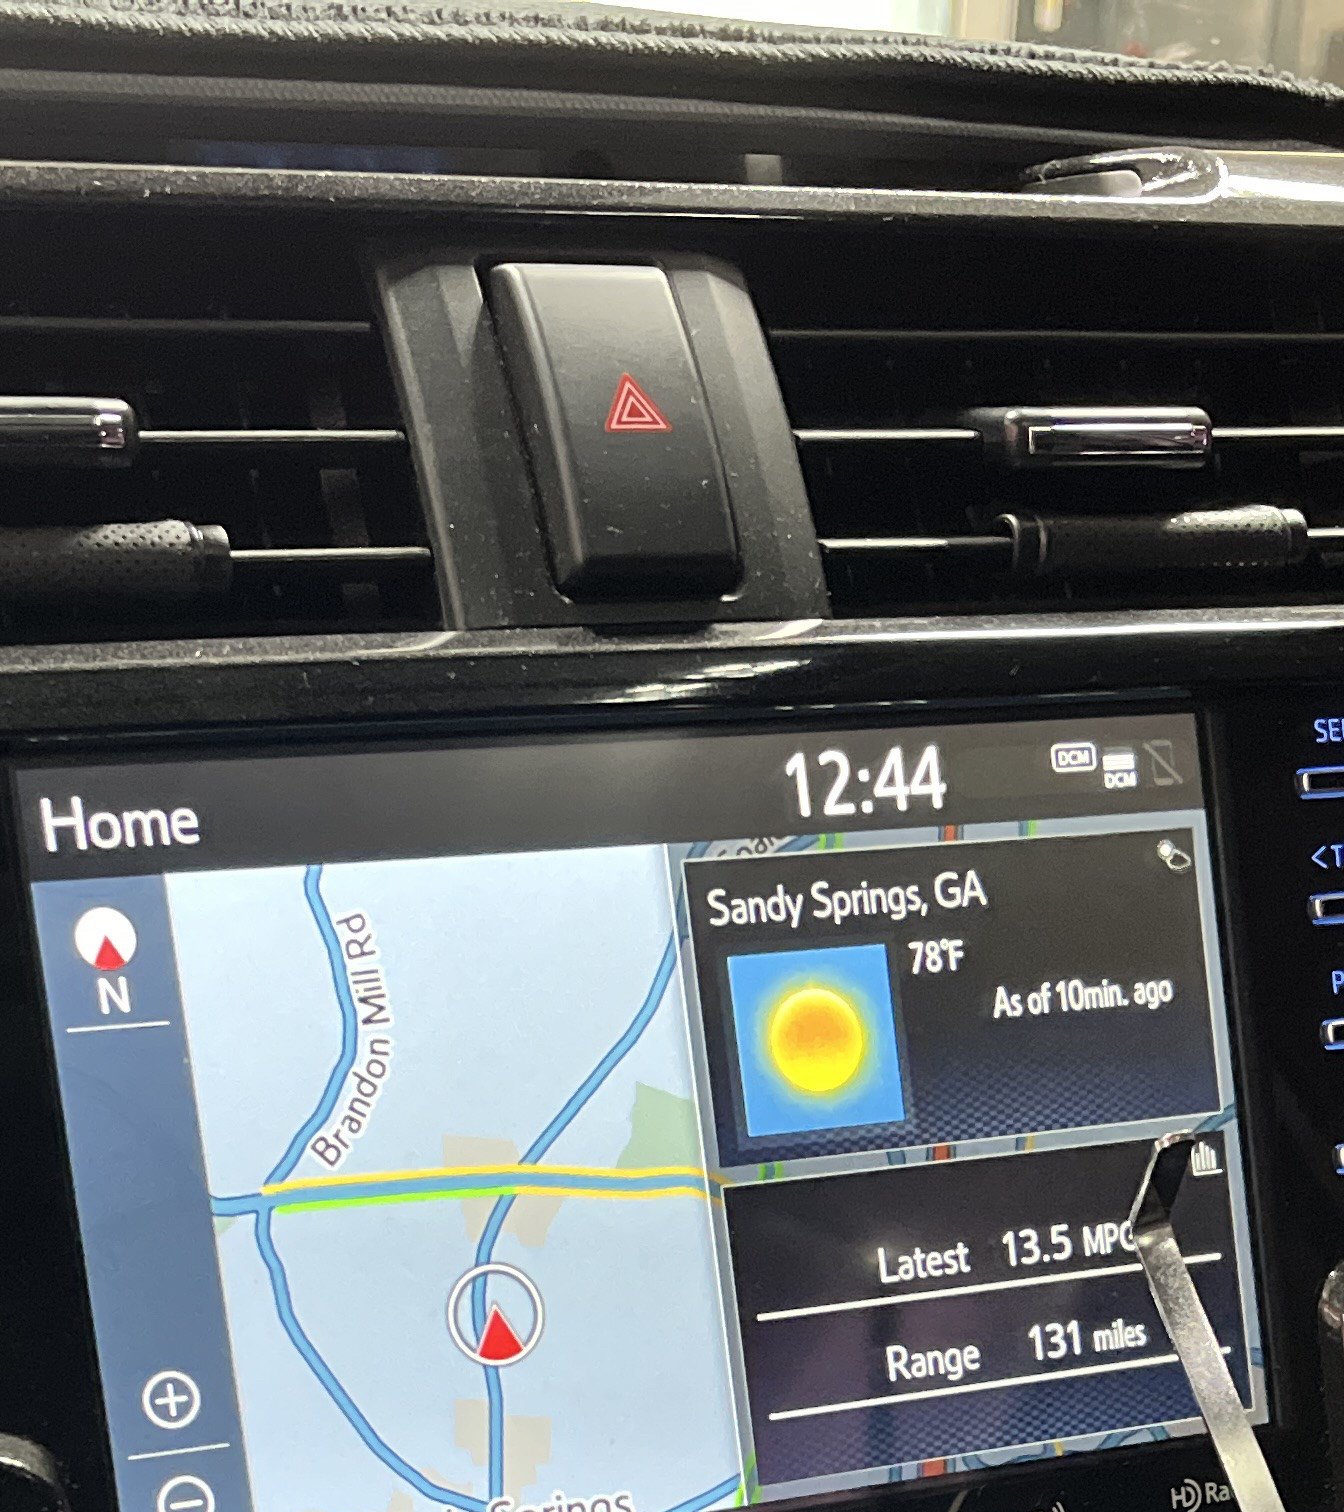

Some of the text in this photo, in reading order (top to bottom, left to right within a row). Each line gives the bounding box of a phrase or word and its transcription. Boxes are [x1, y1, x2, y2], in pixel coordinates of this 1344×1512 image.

[786, 744, 948, 818] 12:44
[1057, 750, 1090, 767] DCM
[40, 796, 201, 853] Home
[707, 869, 989, 928] Sandy Springs, GA
[908, 937, 964, 975] 78°F
[97, 975, 131, 1014] N
[993, 978, 1173, 1018] As of 10min. ago
[310, 912, 391, 1168] Brandon Mill Rd
[878, 1240, 972, 1284] Latest
[1001, 1222, 1073, 1267] 13.5
[886, 1318, 1148, 1382] Range 131 miles
